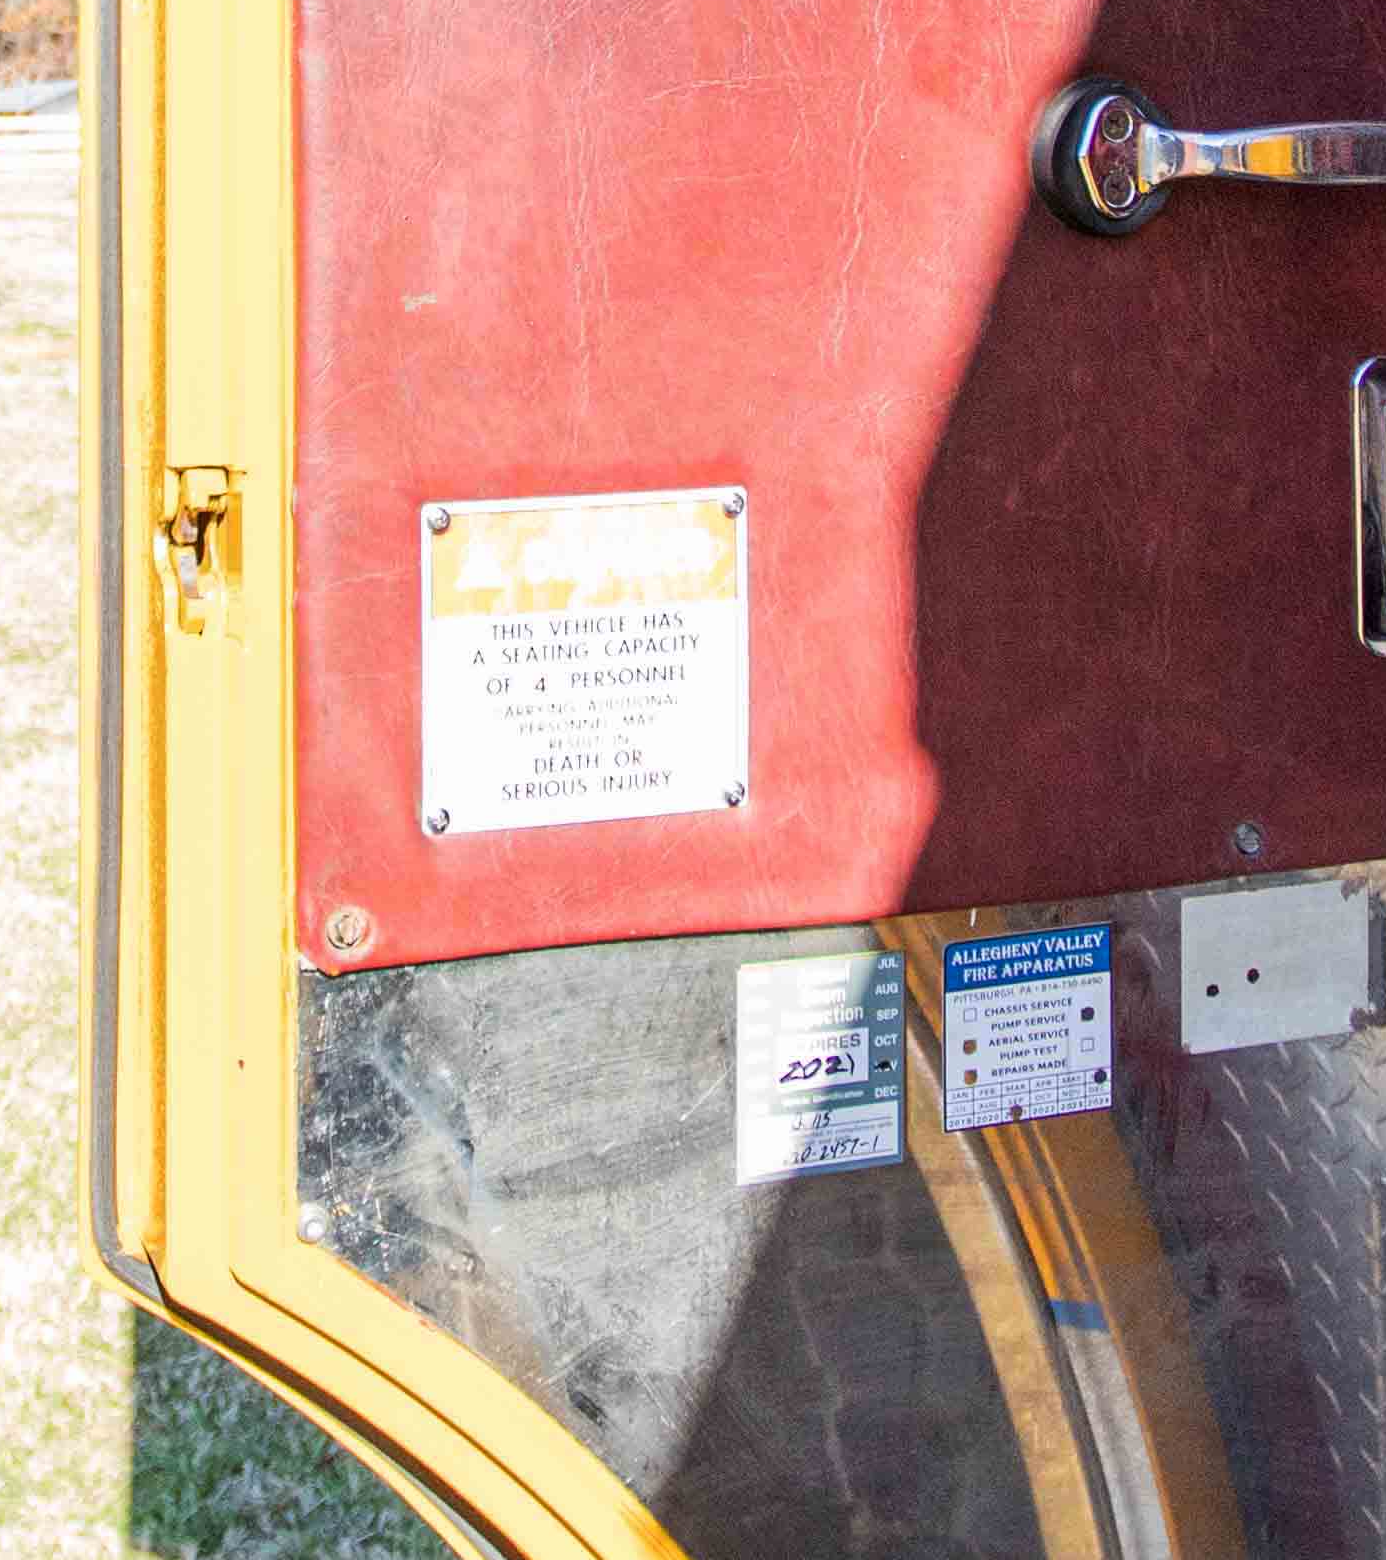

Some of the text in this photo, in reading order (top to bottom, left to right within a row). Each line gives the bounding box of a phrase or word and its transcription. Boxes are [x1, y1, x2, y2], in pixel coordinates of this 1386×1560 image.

[492, 611, 685, 641] THIS VEHICLE HAS
[473, 633, 700, 665] A SEATING CAPACITY
[486, 664, 686, 695] OF 4 PERSONNEL
[534, 748, 643, 775] DEATH OR
[501, 771, 672, 800] SERIOUS INJURY
[951, 931, 1104, 966] ALLEGHENY VALLEY
[877, 957, 899, 970] JUL
[964, 953, 1094, 982] FIRE APPARATUS
[875, 983, 899, 995] AUG
[876, 1008, 899, 1022] SEP
[984, 997, 1073, 1017] CHASSIS SERVICE
[991, 1013, 1066, 1032] PUMP SERVICE
[874, 1034, 898, 1047] OCT
[988, 1028, 1070, 1047] AERIAL SERVICE
[999, 1045, 1058, 1061] PUMP TEST
[991, 1058, 1067, 1077] REPAIRS MADE
[875, 1086, 898, 1099] DEC
